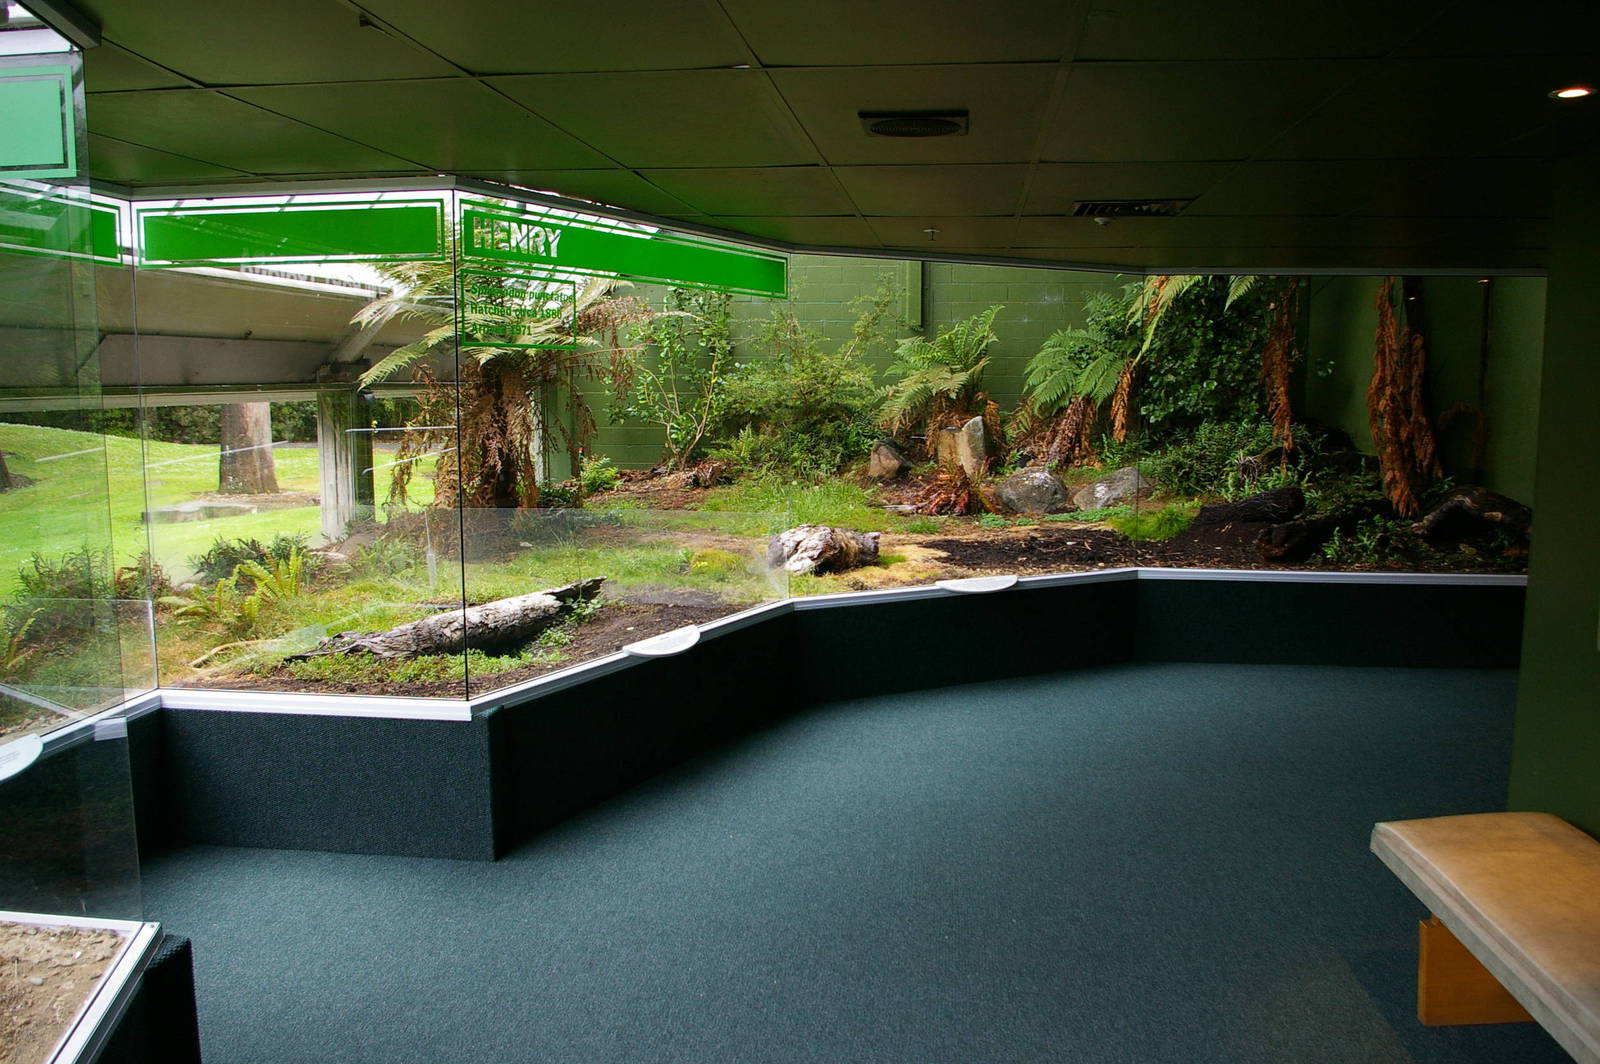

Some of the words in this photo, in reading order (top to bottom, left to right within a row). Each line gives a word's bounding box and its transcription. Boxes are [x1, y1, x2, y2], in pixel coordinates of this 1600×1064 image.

[472, 216, 561, 258] HENRY
[470, 283, 526, 299] Sphodon
[470, 303, 512, 316] Hatched
[471, 322, 508, 335] Arri
[511, 324, 532, 336] 1971
